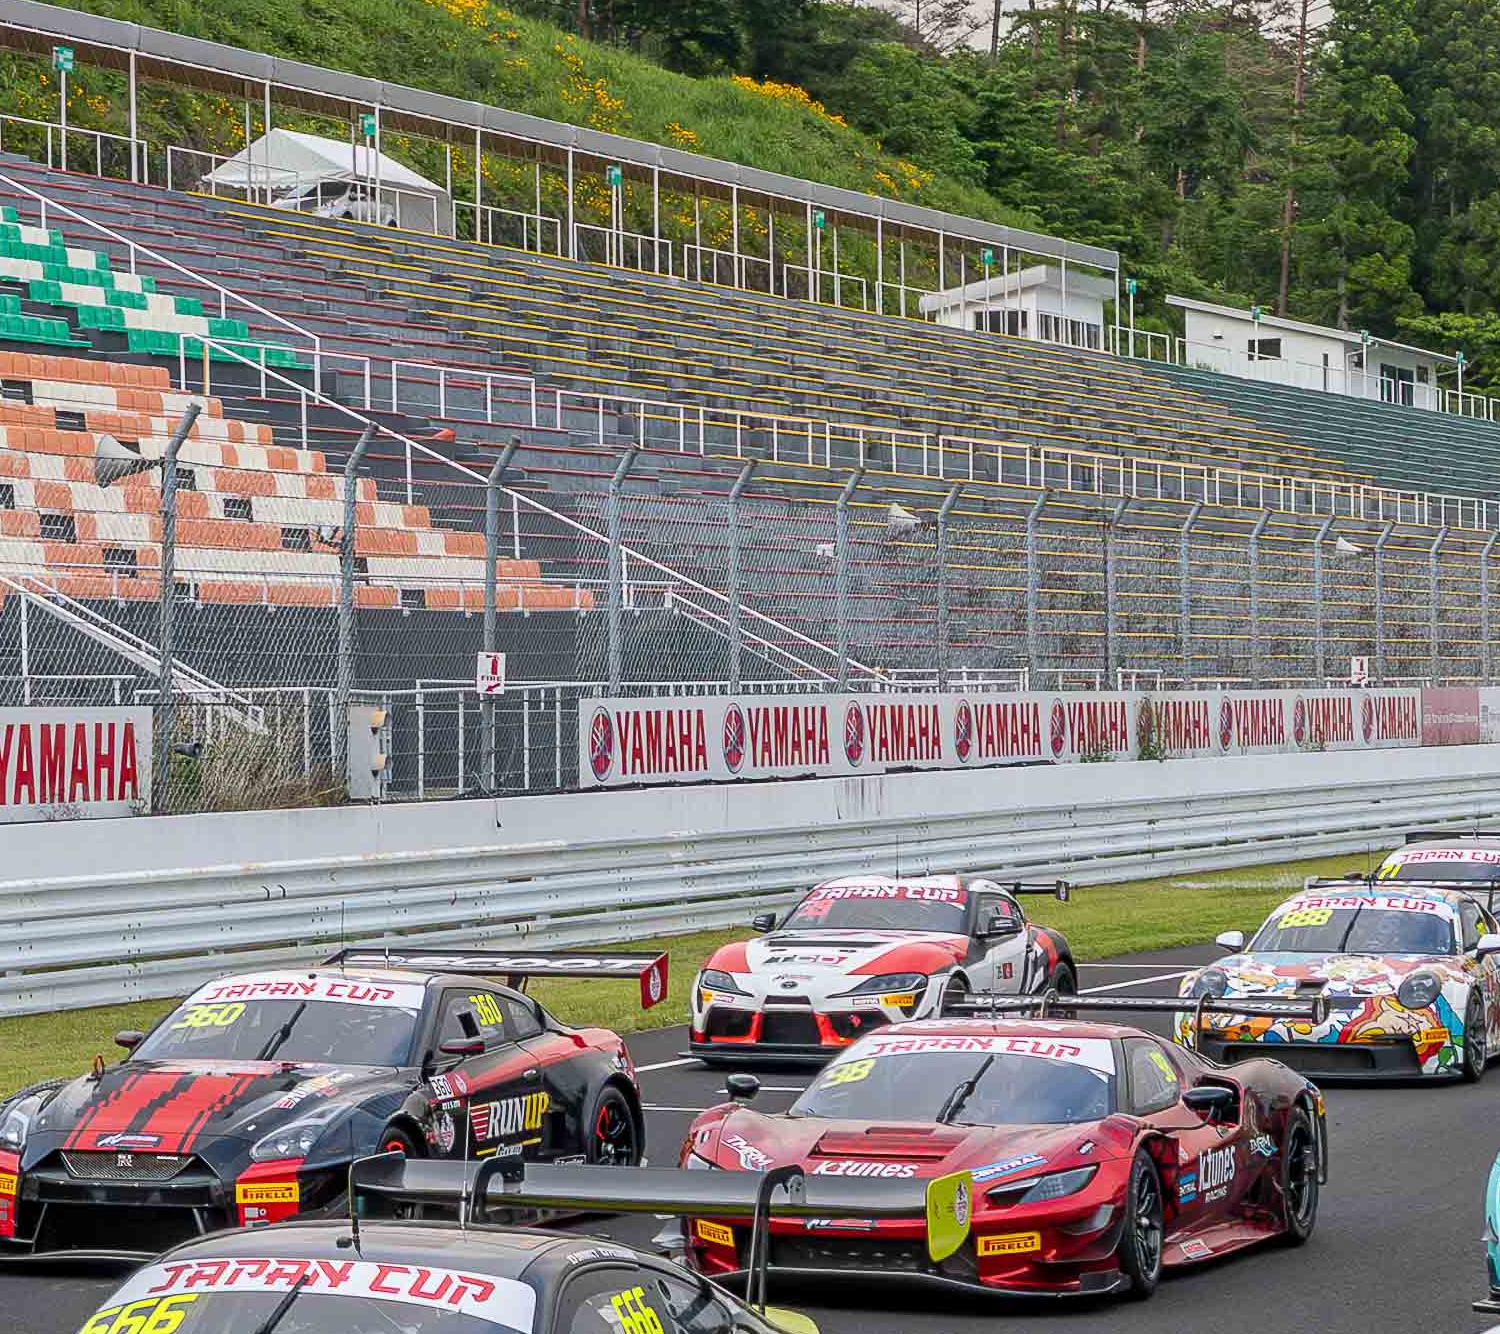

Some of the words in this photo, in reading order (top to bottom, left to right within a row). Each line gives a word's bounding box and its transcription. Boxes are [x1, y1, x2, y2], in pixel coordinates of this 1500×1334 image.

[747, 705, 831, 767] YAMAHA
[866, 704, 943, 763] YAMAHA
[974, 701, 1043, 758] YAMAHA
[1067, 701, 1129, 754] YAMAHA
[1154, 700, 1211, 750] YAMAHA
[1234, 698, 1286, 747] YAMAHA
[1307, 697, 1354, 743] YAMAHA
[1376, 696, 1418, 741] YAMAHA
[616, 709, 709, 775] YAMAHA
[1400, 850, 1464, 864] JAPAN
[813, 885, 900, 901] JAPAN
[903, 887, 959, 902] CUP
[1288, 897, 1377, 913] JAPAN
[1384, 898, 1438, 912] CUP
[204, 981, 315, 1001] JAPAN
[325, 983, 394, 1003] CUP
[468, 992, 503, 1028] 360
[172, 1003, 248, 1028] 360
[866, 1036, 993, 1057] JAPAN
[997, 1038, 1082, 1059] CUP
[431, 1075, 453, 1098] 360
[242, 1185, 294, 1202] PIRELLI
[983, 1234, 1037, 1253] PIRELLI
[146, 1259, 358, 1295] JAPAN
[363, 1264, 498, 1305] CUP
